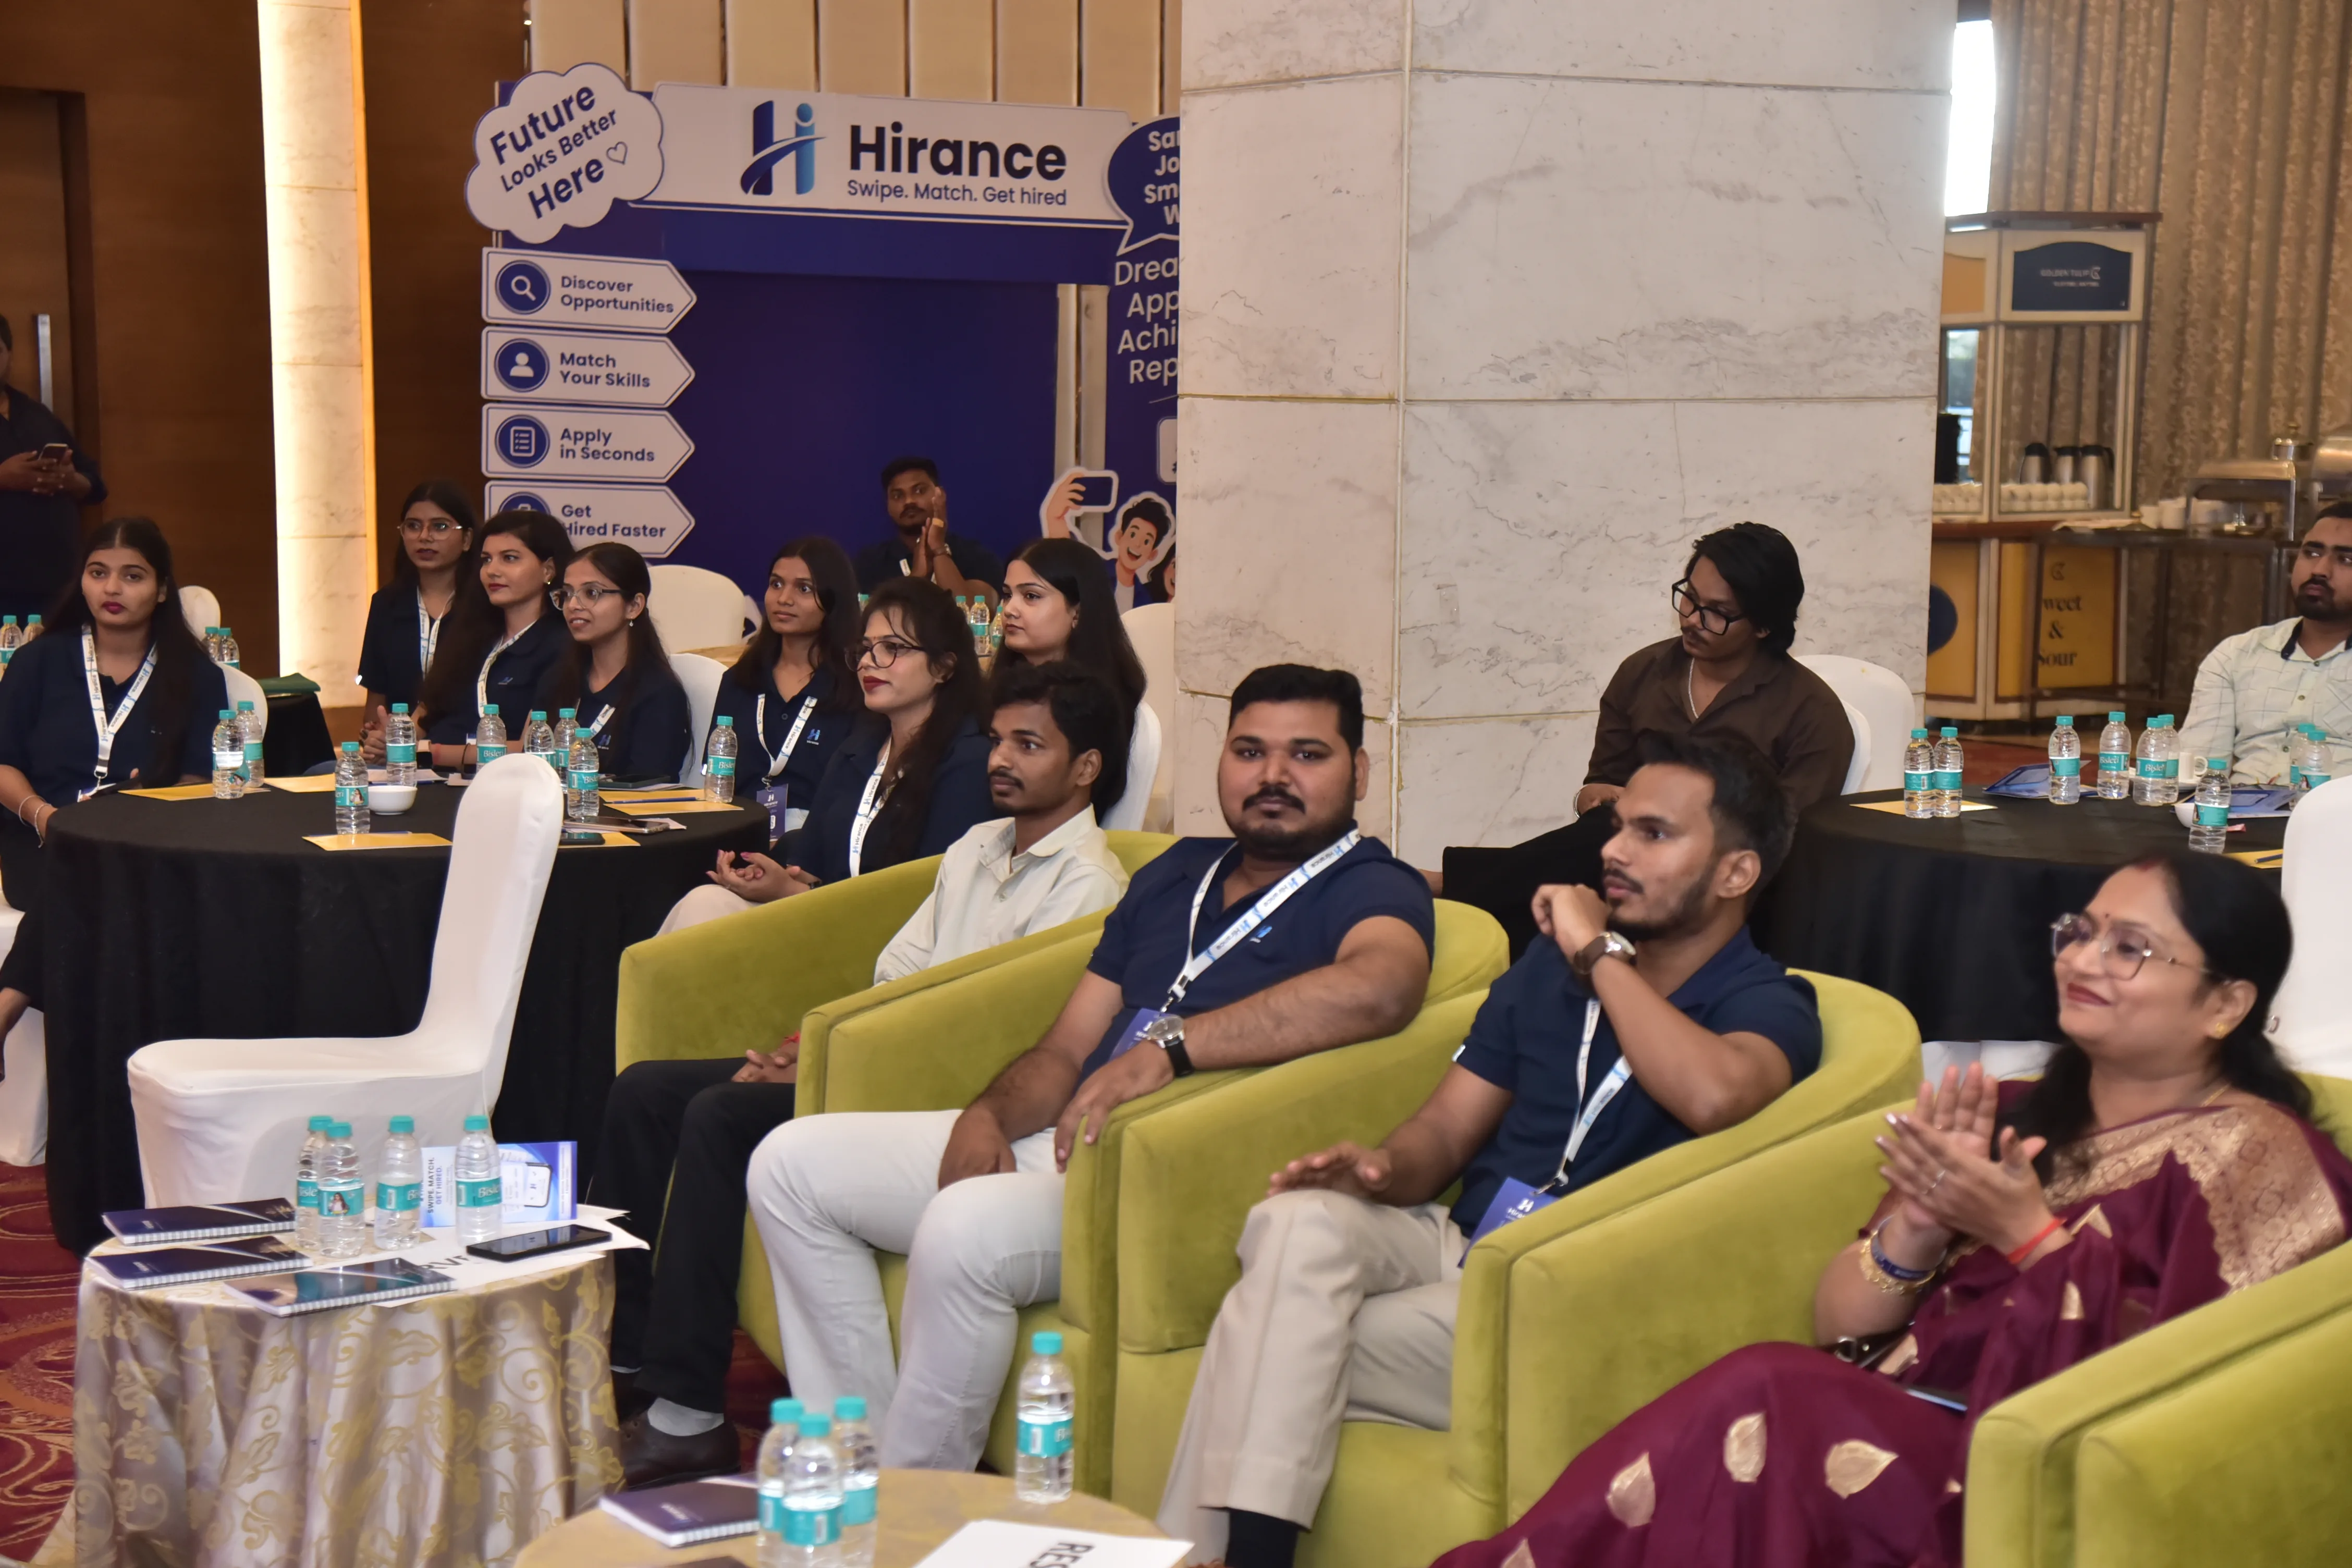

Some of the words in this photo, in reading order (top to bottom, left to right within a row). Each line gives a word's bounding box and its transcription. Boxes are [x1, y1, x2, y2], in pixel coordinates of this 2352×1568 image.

[490, 87, 595, 165] Future
[501, 150, 557, 192] Looks
[558, 109, 617, 156] Better
[850, 121, 1067, 181] Hirance
[528, 158, 605, 219] Here
[848, 180, 908, 202] Swipe.
[914, 183, 977, 201] Match.
[983, 187, 1015, 203] Get
[1020, 187, 1067, 205] hired
[1114, 257, 1178, 286] Drea
[561, 275, 633, 292] Discover
[560, 294, 674, 313] Opportunities
[1126, 291, 1179, 323] App
[1118, 320, 1176, 354] Achi
[560, 352, 616, 368] Match
[559, 370, 601, 385] Your
[605, 372, 651, 387] Skills
[1130, 357, 1178, 386] Rep
[560, 428, 612, 447] Apply
[560, 444, 576, 459] in
[581, 446, 655, 461] Seconds
[561, 505, 592, 518] Get
[612, 524, 666, 537] Faster
[2042, 596, 2081, 611] weet
